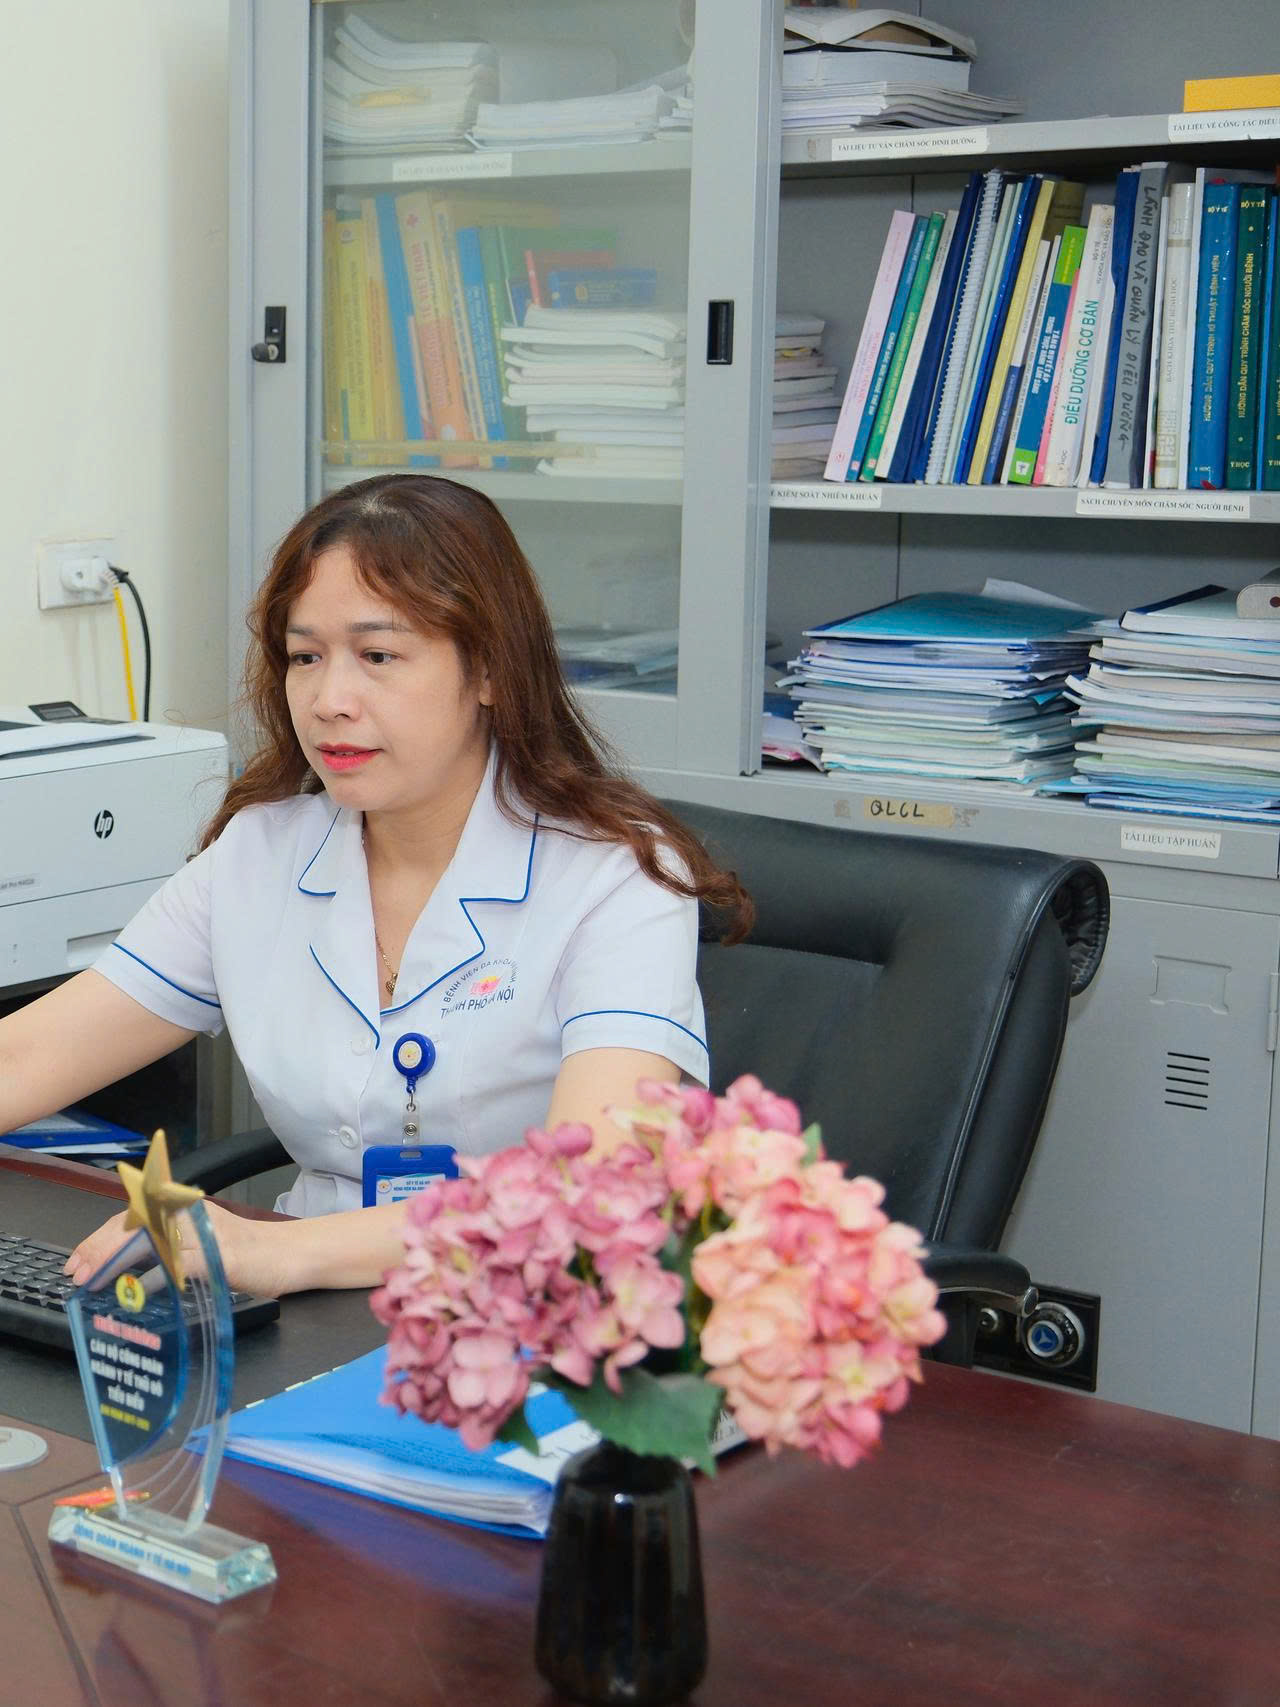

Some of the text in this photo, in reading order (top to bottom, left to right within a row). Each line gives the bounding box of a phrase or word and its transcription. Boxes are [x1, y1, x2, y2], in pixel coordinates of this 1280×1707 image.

[1131, 229, 1151, 257] ĐẠO
[1132, 259, 1149, 284] VÀ
[1244, 252, 1254, 273] BỆNH
[1241, 274, 1252, 297] NGƯỜI
[1075, 297, 1099, 326] BẢN
[1127, 285, 1148, 323] QUẢN
[1241, 298, 1251, 313] SÓC
[1240, 314, 1250, 336] CHĂM
[1077, 326, 1094, 347] CƠ
[1124, 328, 1142, 345] LÝ
[1238, 336, 1249, 358] TRÌNH
[1066, 348, 1090, 394] DƯỠNG
[1205, 358, 1214, 375] QUY
[1239, 359, 1248, 374] QUY
[1102, 498, 1133, 507] CHUYÊN
[1135, 499, 1153, 507] MÔN
[1178, 501, 1194, 509] SÓC
[1195, 502, 1221, 511] NGƯỜI
[1223, 504, 1244, 513] BỆNH
[871, 799, 924, 818] QLCL
[1124, 832, 1139, 841] TÀI
[1140, 833, 1164, 845] LIỆU
[1187, 838, 1216, 849] HUẤN
[497, 985, 514, 1003] NỘI
